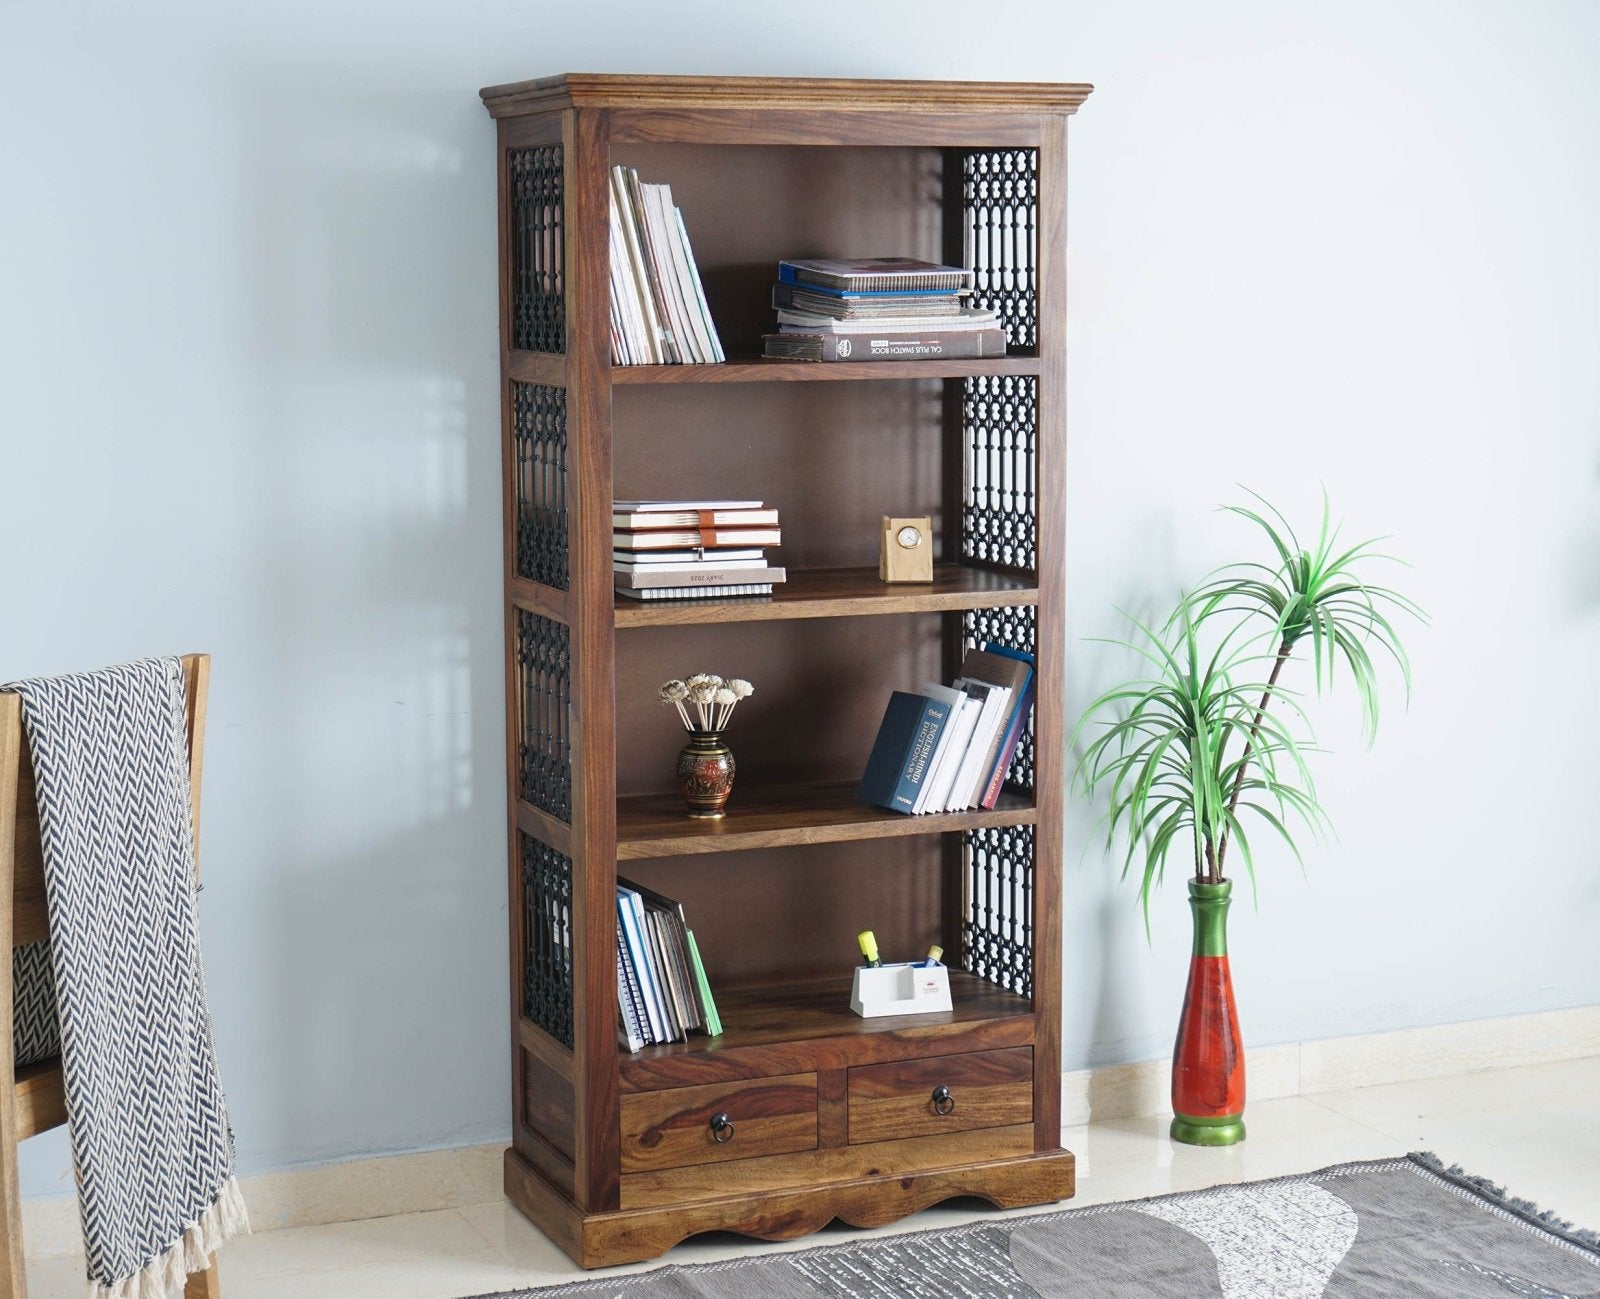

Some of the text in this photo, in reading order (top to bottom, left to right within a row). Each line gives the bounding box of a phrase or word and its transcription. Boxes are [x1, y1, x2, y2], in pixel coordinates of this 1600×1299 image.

[891, 346, 915, 354] SWATCH
[916, 346, 929, 354] PLUS
[705, 575, 724, 583] DIARY
[906, 721, 930, 780] DICTIONARY
[911, 722, 939, 784] ENGLISH-HINDI
